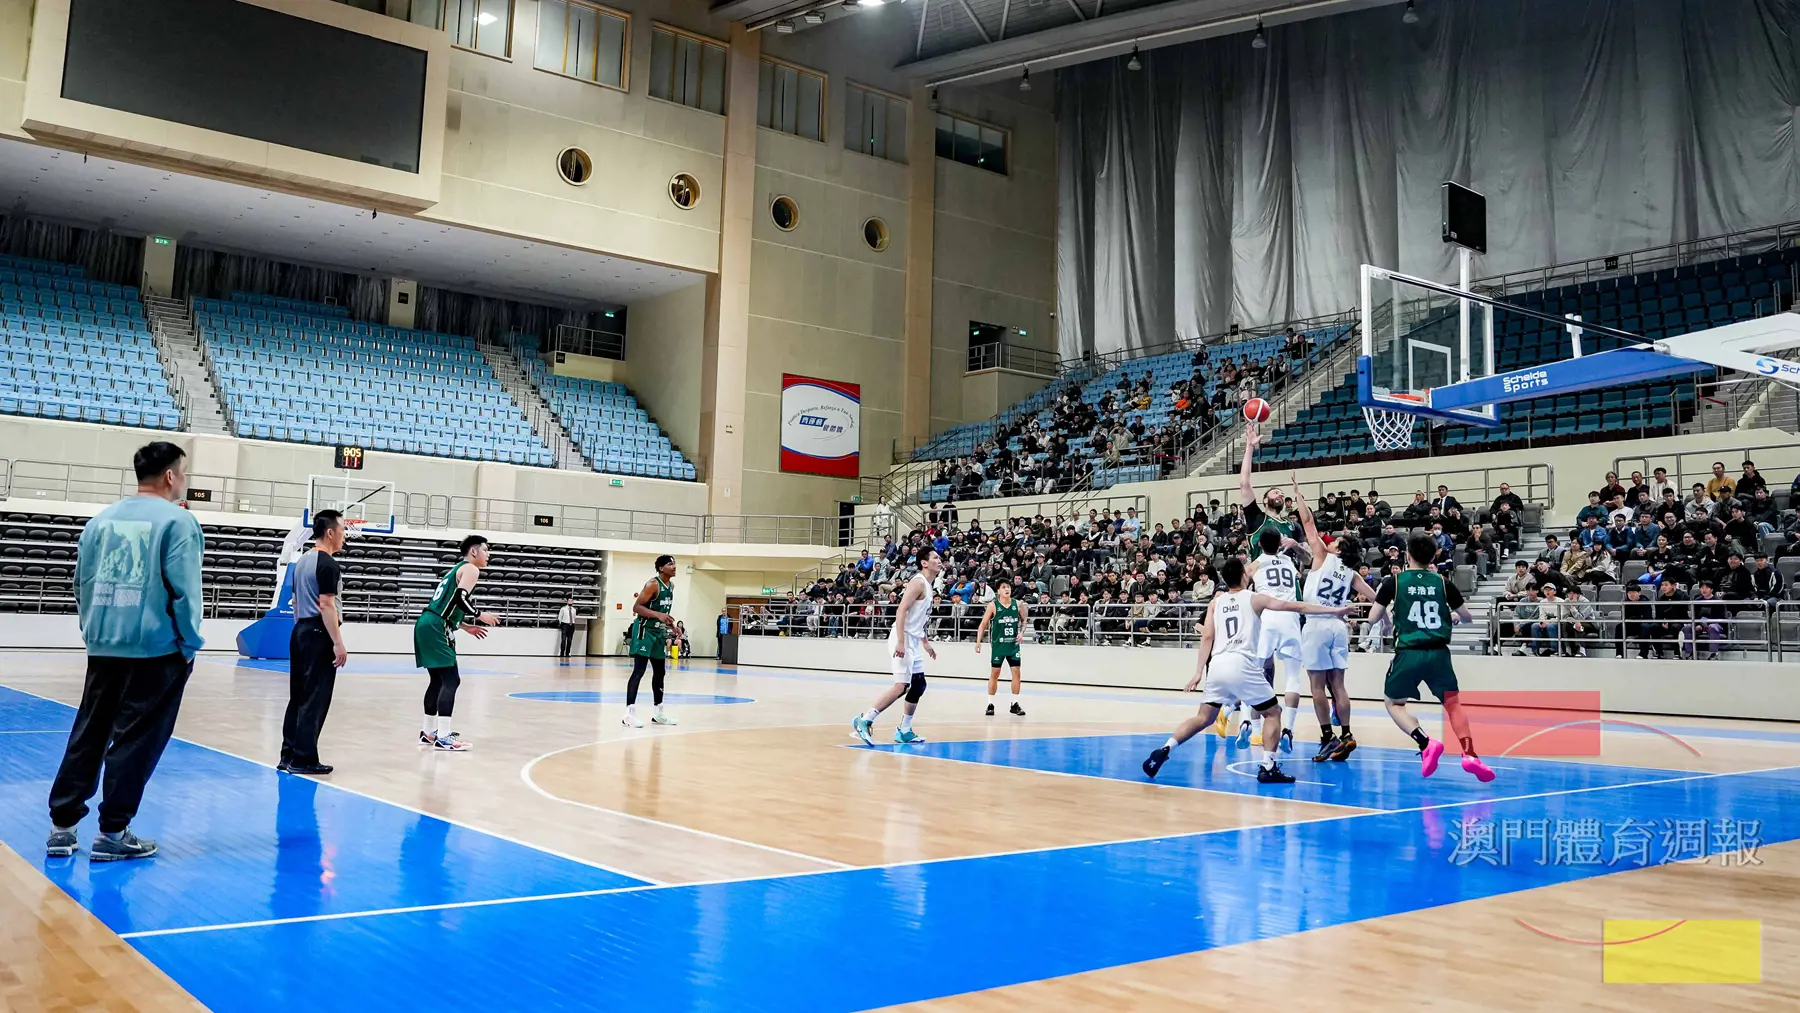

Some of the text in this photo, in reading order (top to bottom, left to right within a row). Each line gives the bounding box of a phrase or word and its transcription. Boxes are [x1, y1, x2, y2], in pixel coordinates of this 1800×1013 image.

[1504, 378, 1549, 393] Sports
[1266, 567, 1294, 588] 99
[1333, 571, 1346, 582] DIAZ
[1317, 577, 1346, 605] 24
[1223, 604, 1240, 613] CHAO
[1407, 600, 1442, 629] 48
[1004, 627, 1014, 636] 69
[1225, 616, 1238, 639] 0
